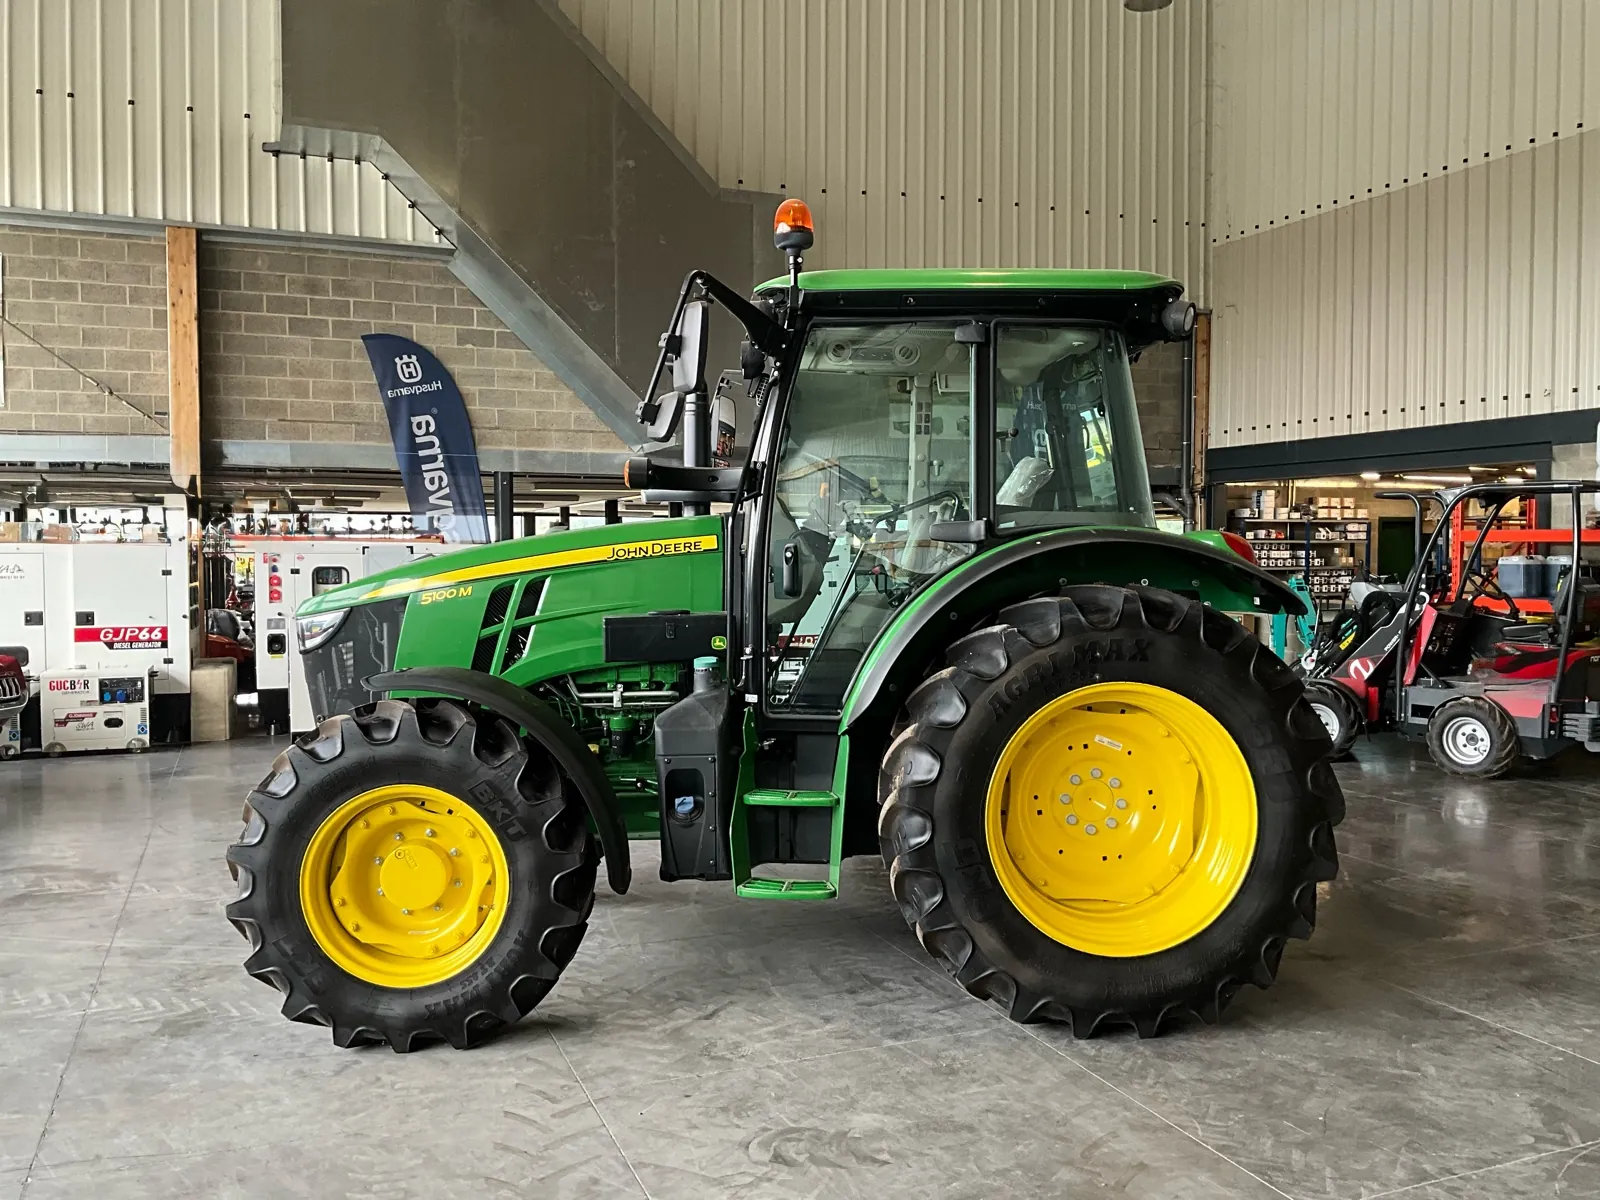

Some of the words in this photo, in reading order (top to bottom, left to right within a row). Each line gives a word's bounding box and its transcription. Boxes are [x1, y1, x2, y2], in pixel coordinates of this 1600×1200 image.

[606, 546, 649, 560] JOHN
[651, 541, 703, 555] DEERE
[420, 589, 457, 605] 5100
[458, 585, 473, 598] M
[99, 627, 163, 641] GJP66
[131, 641, 162, 649] GENERATOR
[467, 779, 529, 842] BKT
